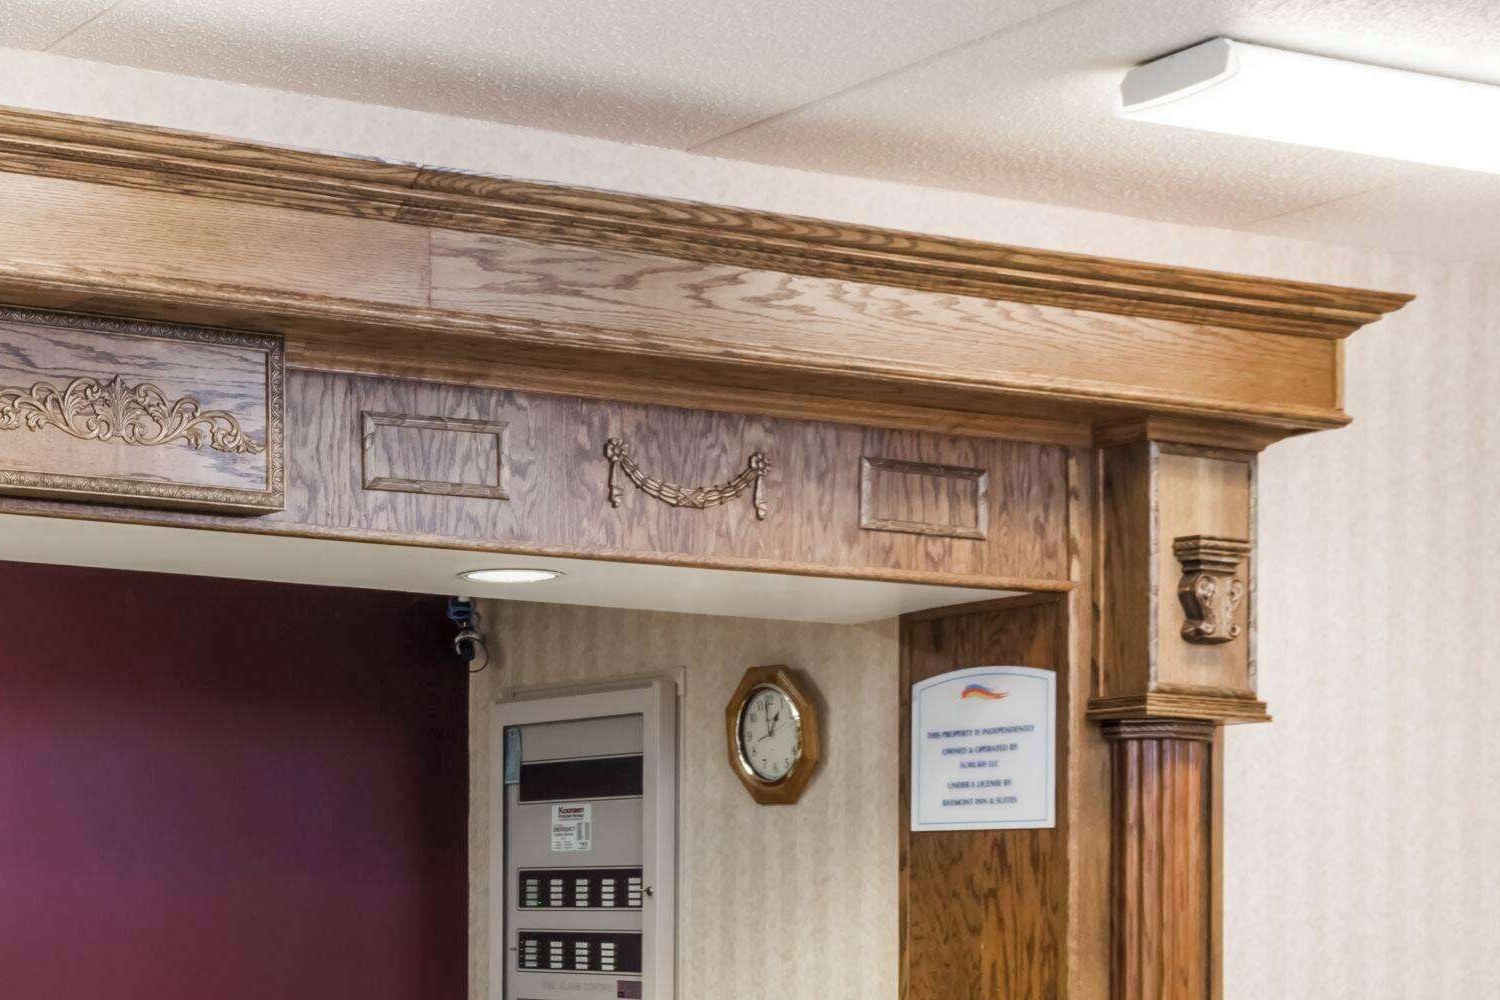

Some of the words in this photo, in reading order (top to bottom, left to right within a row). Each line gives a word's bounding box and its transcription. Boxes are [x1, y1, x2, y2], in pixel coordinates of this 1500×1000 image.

[942, 729, 972, 737] PROPERTY
[982, 725, 1034, 734] INDEPENDENTLY
[942, 747, 967, 755] OWNED
[975, 744, 1008, 753] OPERATED
[976, 780, 1001, 788] LICENSE
